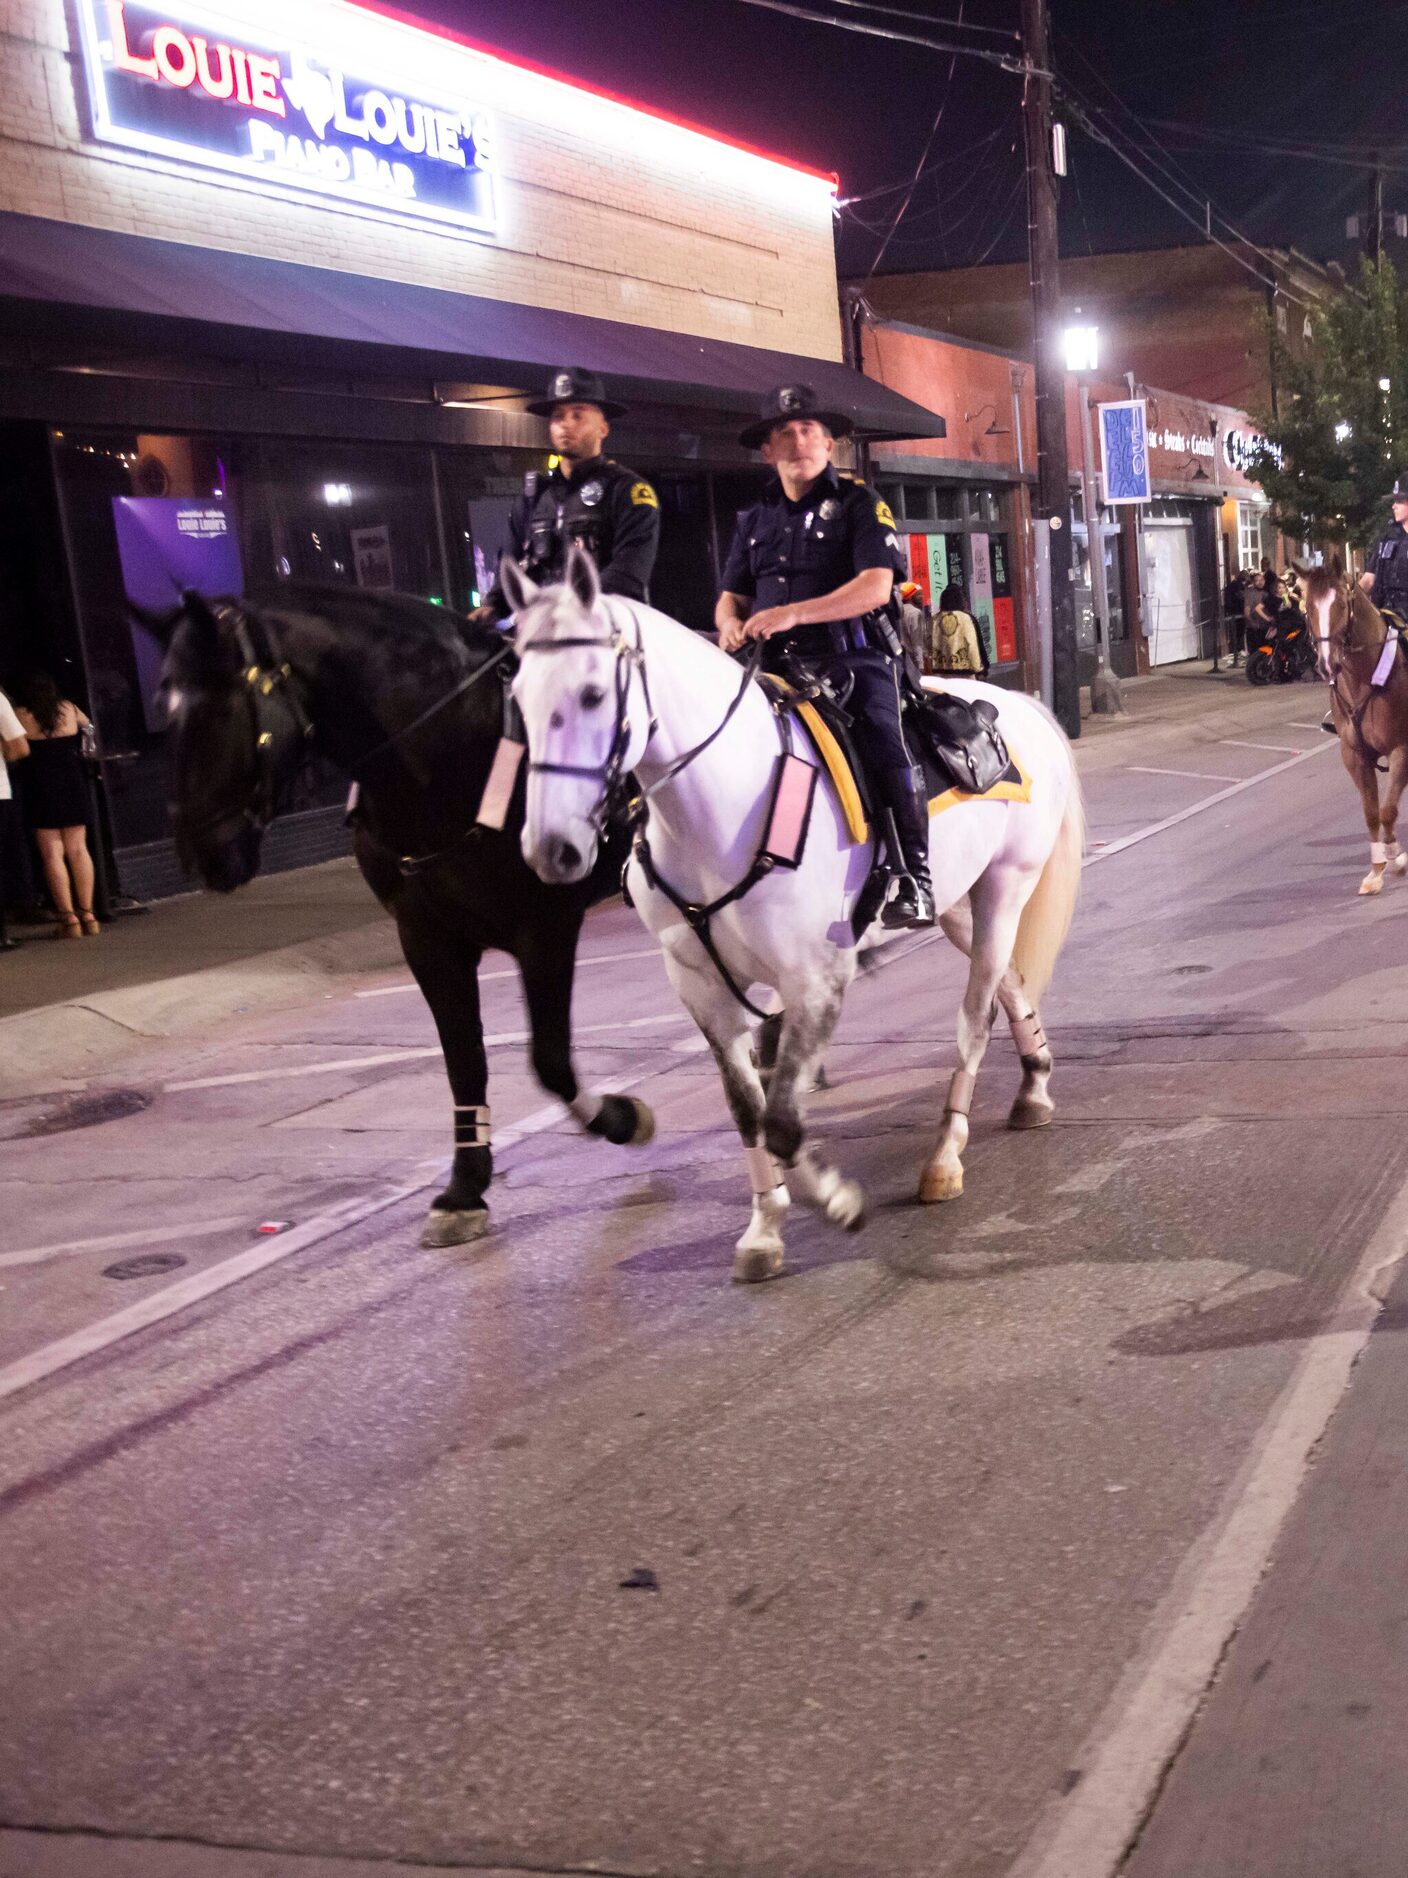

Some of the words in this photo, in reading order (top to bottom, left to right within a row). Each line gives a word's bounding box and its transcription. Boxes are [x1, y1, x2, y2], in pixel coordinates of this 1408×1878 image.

[108, 0, 286, 118] LOUIE
[326, 67, 495, 170] LOUIE'S
[352, 147, 417, 199] BAR
